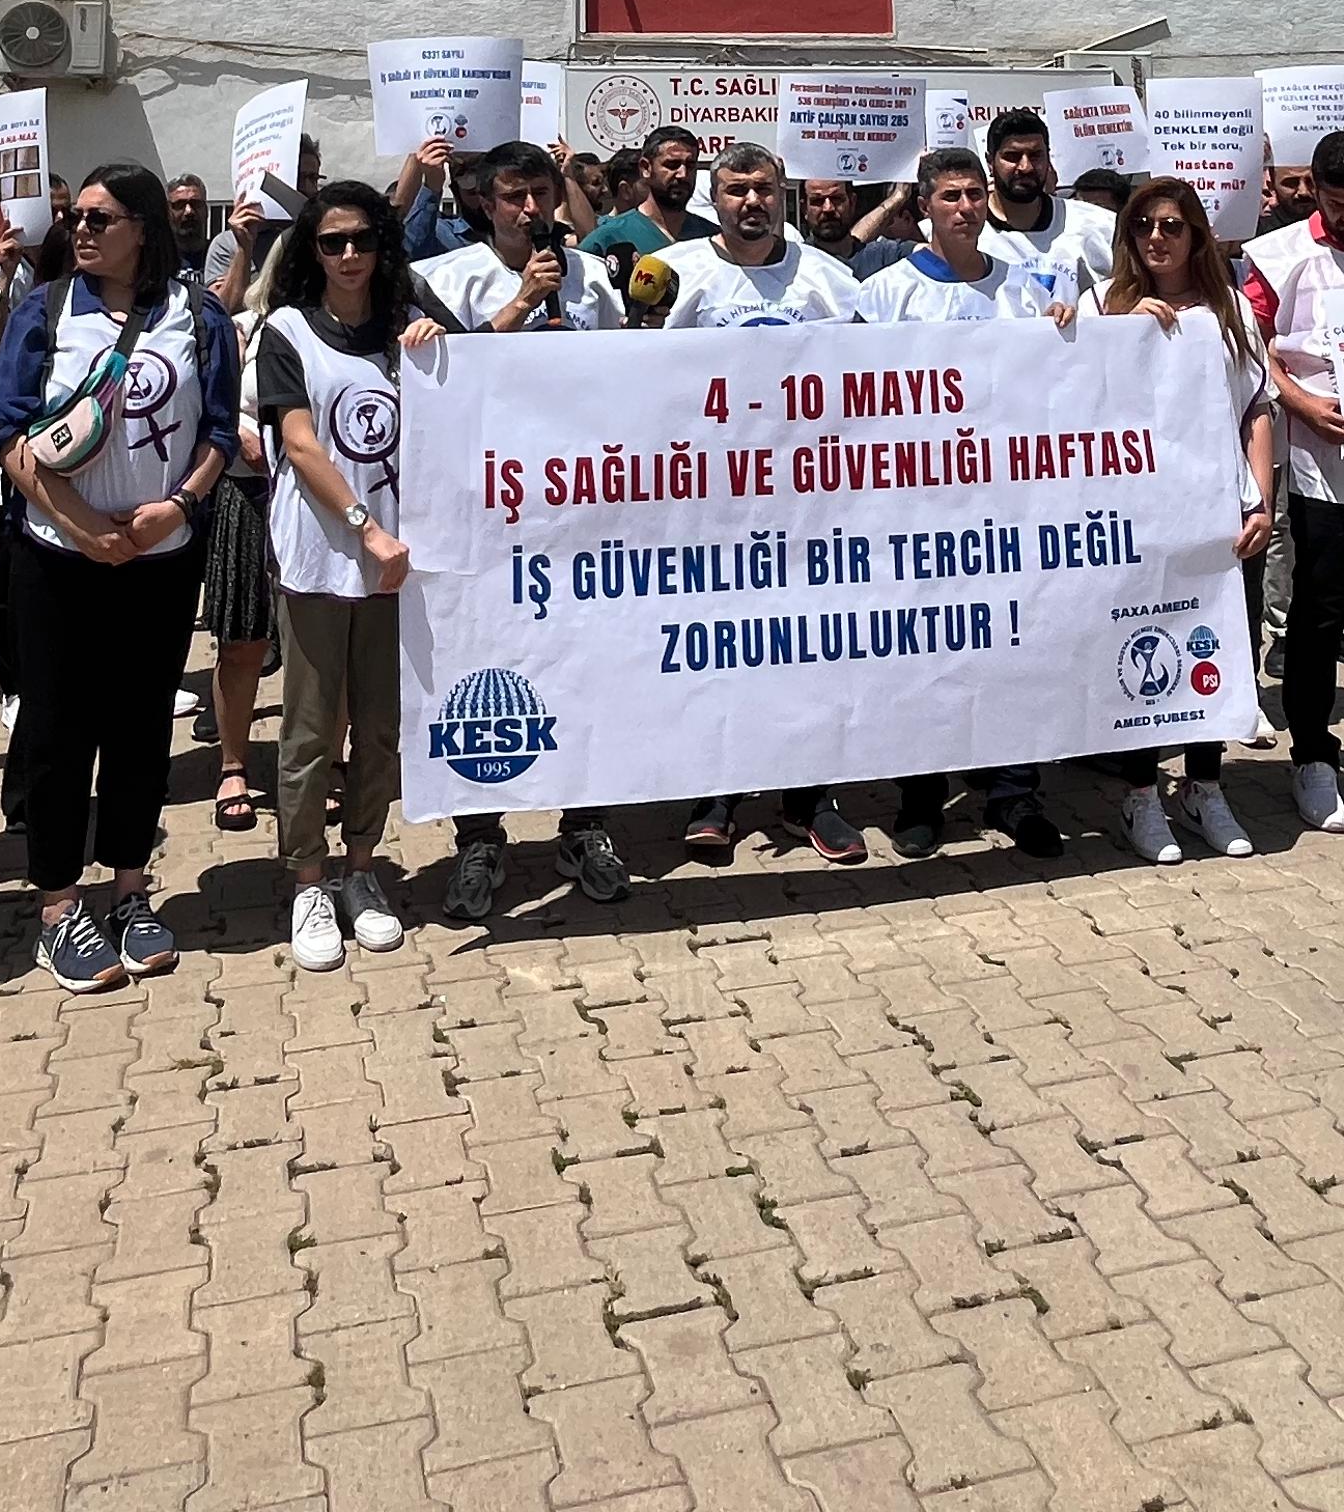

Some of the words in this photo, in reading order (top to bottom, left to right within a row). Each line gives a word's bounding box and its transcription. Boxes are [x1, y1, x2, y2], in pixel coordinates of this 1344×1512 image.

[422, 50, 440, 60] 6331
[670, 77, 709, 96] T.C.
[715, 74, 778, 96] SAĞLI
[790, 110, 815, 124] AKTİF
[818, 111, 857, 128] ÇALIŞAN
[859, 113, 888, 126] SAYISI
[891, 115, 909, 127] 285
[1154, 111, 1170, 119] 40
[1174, 109, 1252, 120] bilinmeyenli
[1154, 126, 1218, 135] DENKLEM
[1223, 125, 1254, 136] değil
[1162, 141, 1186, 151] Tek
[1190, 141, 1206, 150] bir
[1211, 143, 1243, 152] soru,
[1175, 160, 1234, 170] Hastane
[1221, 179, 1246, 190] mü?
[704, 378, 729, 424] 4
[781, 374, 824, 421] 10
[842, 368, 964, 418] MAYIS
[484, 450, 524, 524] İŞ
[545, 441, 707, 506] SAĞLIĞI
[727, 449, 774, 497] VE
[1008, 428, 1156, 481] HAFTASI
[512, 545, 551, 620] İŞ
[806, 527, 871, 585] BİR
[889, 518, 1022, 581] TERCİH
[1038, 510, 1142, 570] DEĞİL
[1111, 605, 1149, 623] ŞAXA
[660, 602, 992, 674] ZORUNLULUKTUR
[1009, 600, 1021, 646] !
[1186, 639, 1220, 651] KESK
[1114, 716, 1150, 729] AMED
[1153, 710, 1206, 727] ŞUBESİ
[429, 716, 558, 759] KESK
[476, 761, 511, 778] 1995
